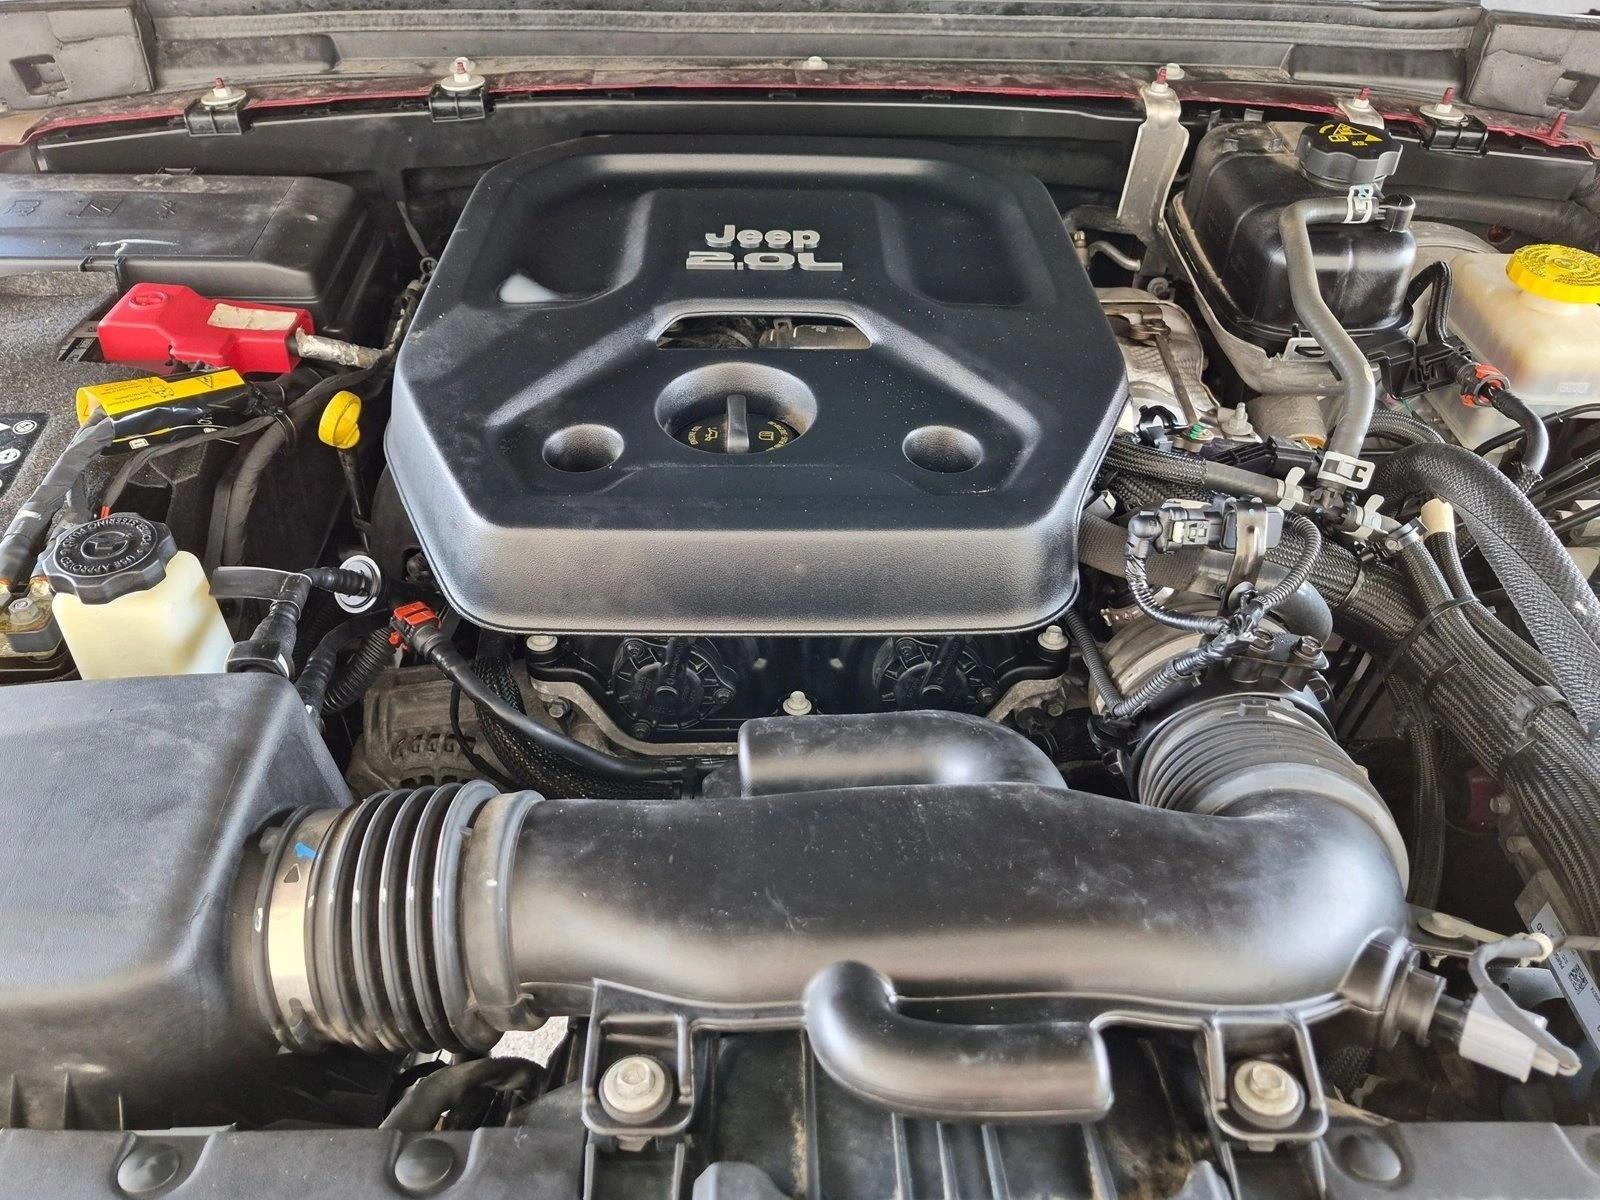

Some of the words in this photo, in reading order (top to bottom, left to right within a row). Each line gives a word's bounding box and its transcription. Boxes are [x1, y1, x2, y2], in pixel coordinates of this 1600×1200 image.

[705, 224, 821, 252] Jeep
[686, 251, 843, 272] 2.0L
[87, 517, 138, 529] STEERING
[60, 556, 109, 573] APPROVED
[114, 554, 135, 569] USE
